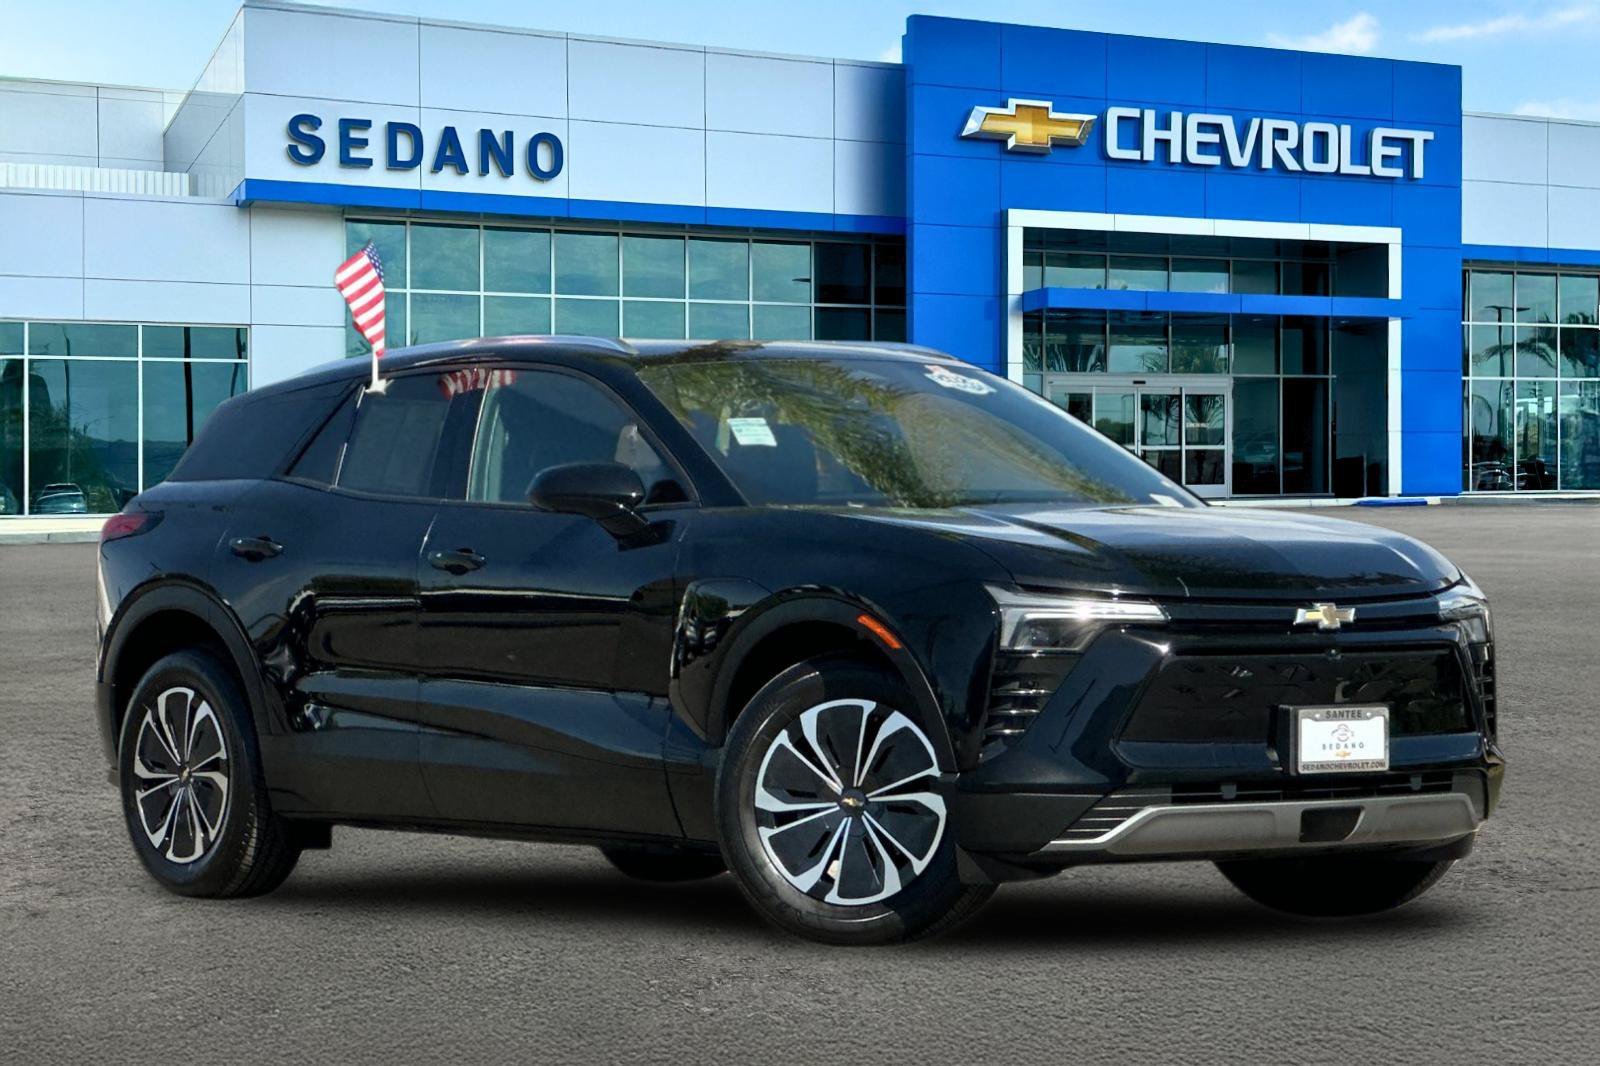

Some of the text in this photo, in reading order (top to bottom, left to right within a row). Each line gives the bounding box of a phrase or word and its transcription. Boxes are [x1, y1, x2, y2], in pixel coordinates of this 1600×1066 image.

[286, 113, 564, 182] SEDANO
[1106, 106, 1434, 179] CHEVROLET
[1325, 710, 1362, 719] SANTEE
[1322, 742, 1364, 750] SEDANO
[1302, 761, 1386, 771] SEDANOCHEVROLET.COM
